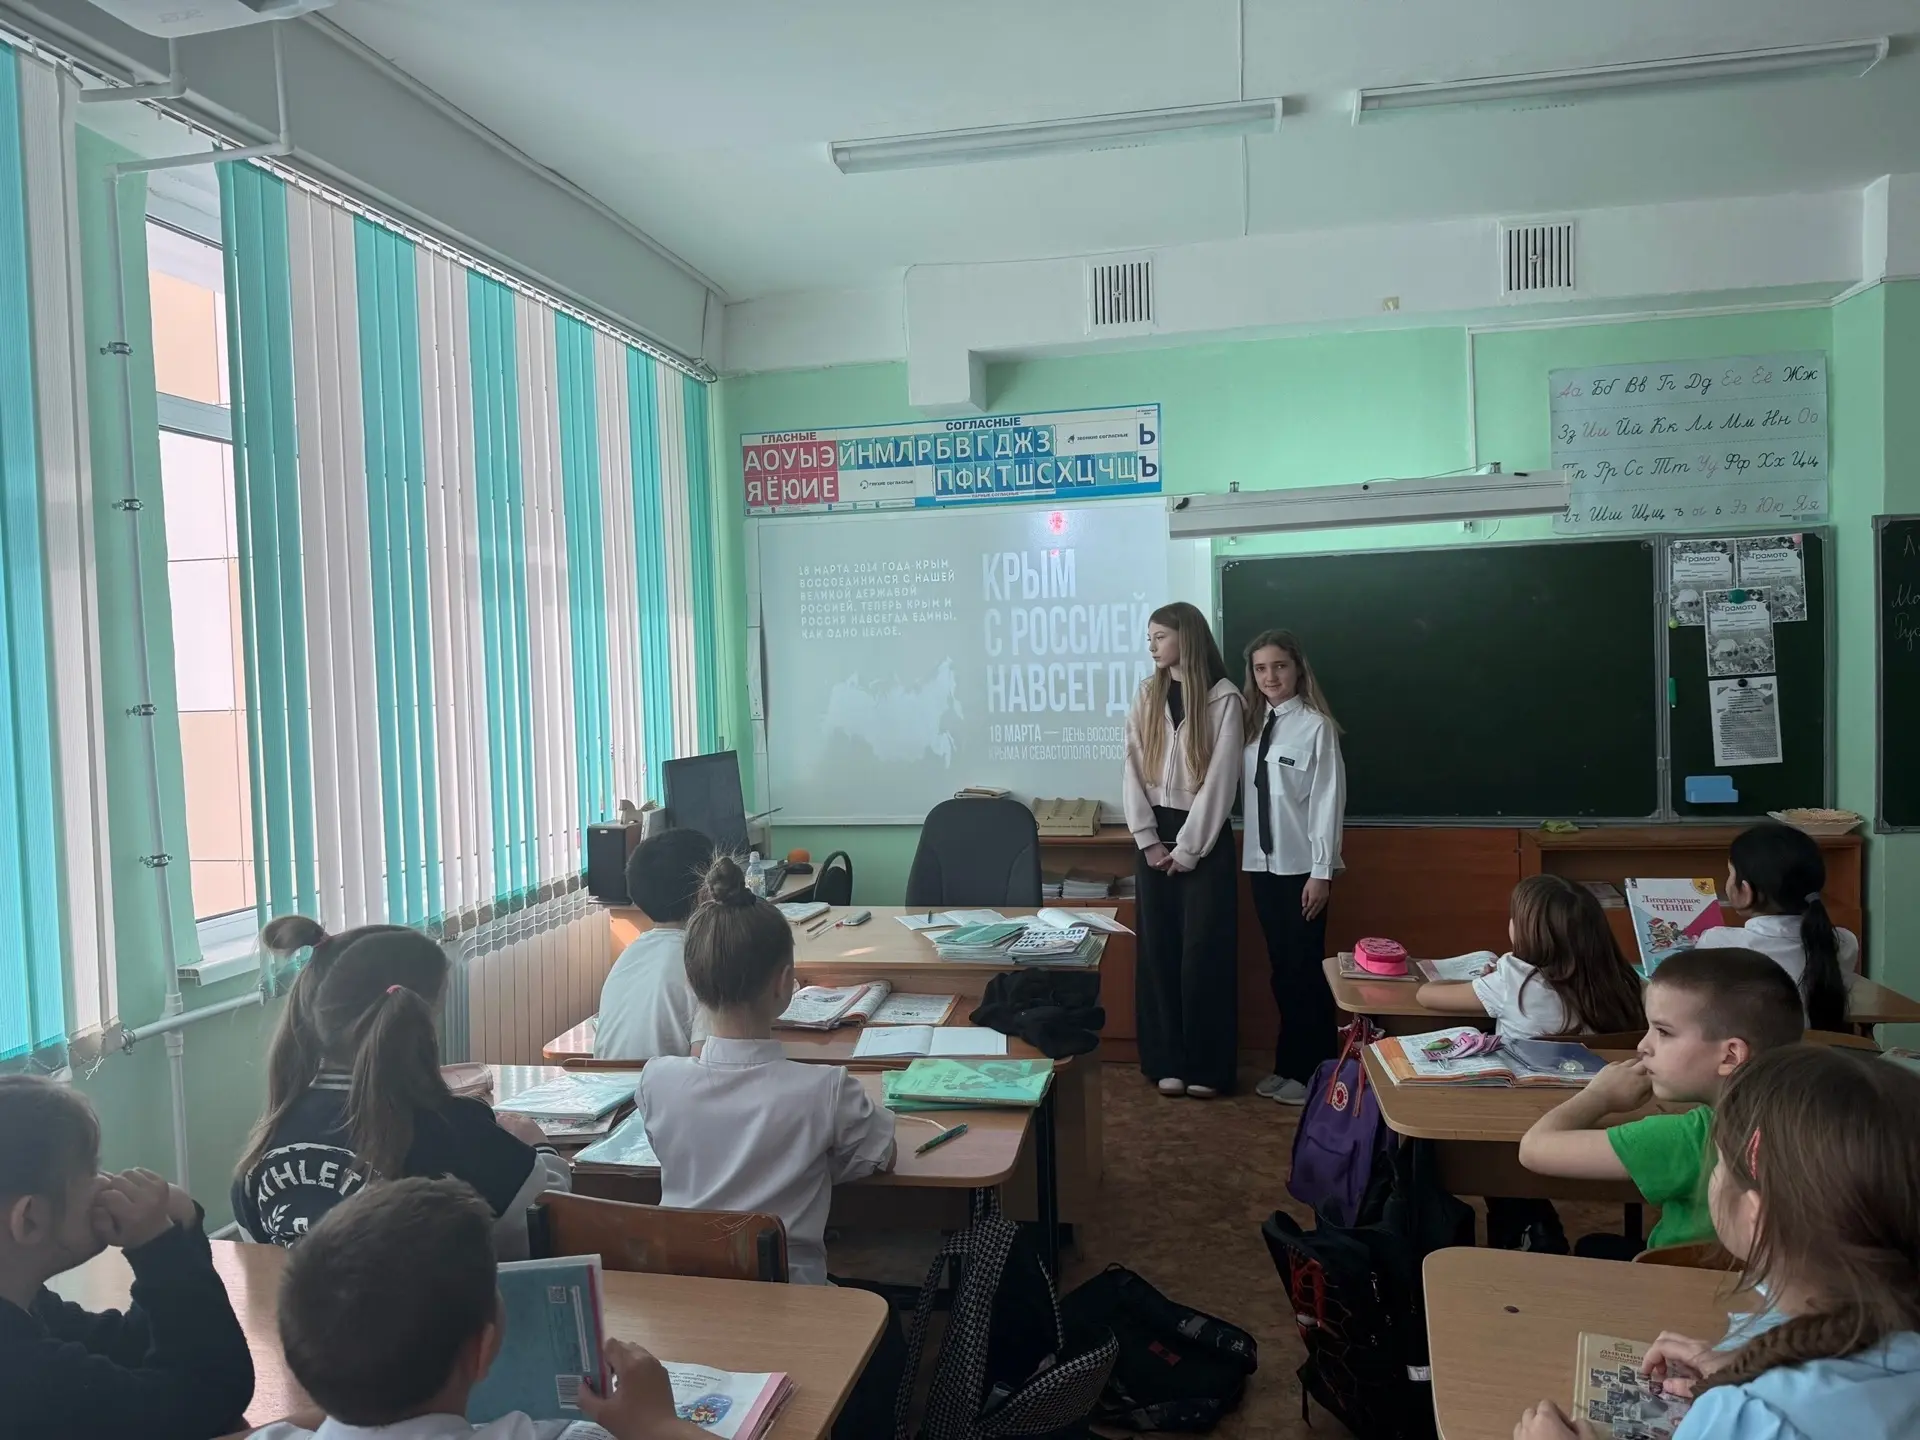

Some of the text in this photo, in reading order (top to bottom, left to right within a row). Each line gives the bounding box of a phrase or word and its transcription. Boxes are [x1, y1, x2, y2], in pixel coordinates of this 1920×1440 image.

[1557, 365, 1819, 399] Аа Бб Вв Гг Дд Ее Ёё Жж
[946, 416, 1021, 431] СОГЛАСНЫЕ
[1558, 407, 1819, 445] Зз Ии Йй Кк Лл Мм Нн Оо
[762, 432, 817, 444] ГЛАСНЫЕ
[1139, 423, 1155, 445] Ь
[1138, 456, 1157, 478] Ъ
[1593, 461, 1618, 485] Рр
[1624, 459, 1643, 477] Сс
[1650, 456, 1690, 475] Тт
[1698, 453, 1718, 479] Уу
[1724, 452, 1751, 476] Фф
[1757, 452, 1786, 469] Хх
[1791, 450, 1819, 468] Цц
[1590, 506, 1623, 521] Шш
[1631, 503, 1666, 522] Щщ
[1730, 499, 1747, 515] Ээ
[1755, 496, 1785, 513] Юю
[1792, 493, 1819, 512] Яя
[1684, 555, 1720, 563] Грамота
[1751, 551, 1788, 560] Грамота
[814, 564, 850, 576] МАРТА
[854, 562, 878, 574] 2014
[882, 561, 910, 572] ГОДА
[915, 558, 950, 570] КРЫМ
[982, 548, 1077, 601] КРЫМ
[800, 569, 956, 588] ВОССОЕДИНИЛСЯ С НАШЕЙ
[800, 586, 918, 601] ВЕЛИКОЙ ДЕРЖАВОЙ
[801, 597, 952, 614] РОССИЕЙ. ТЕПЕРЬ КРЫМ И
[1720, 603, 1757, 612] Грамота
[801, 614, 847, 627] РОССИЯ
[851, 613, 908, 625] НАВСЕГДА
[984, 592, 1150, 657] С РОССИЕЙ
[801, 628, 824, 640] КАК
[827, 626, 857, 639] ОДНО
[990, 724, 1001, 742] 18
[1004, 723, 1042, 742] МАРТА
[1062, 727, 1085, 743] ДЕНЬ
[989, 745, 1020, 760] КРЫМА
[1022, 746, 1028, 760] И
[1029, 745, 1091, 760] СЕВАСТОПОЛЯ
[1092, 745, 1099, 759] С
[1642, 895, 1700, 905] Литературное
[1652, 904, 1694, 912] ЧТЕНИЕ
